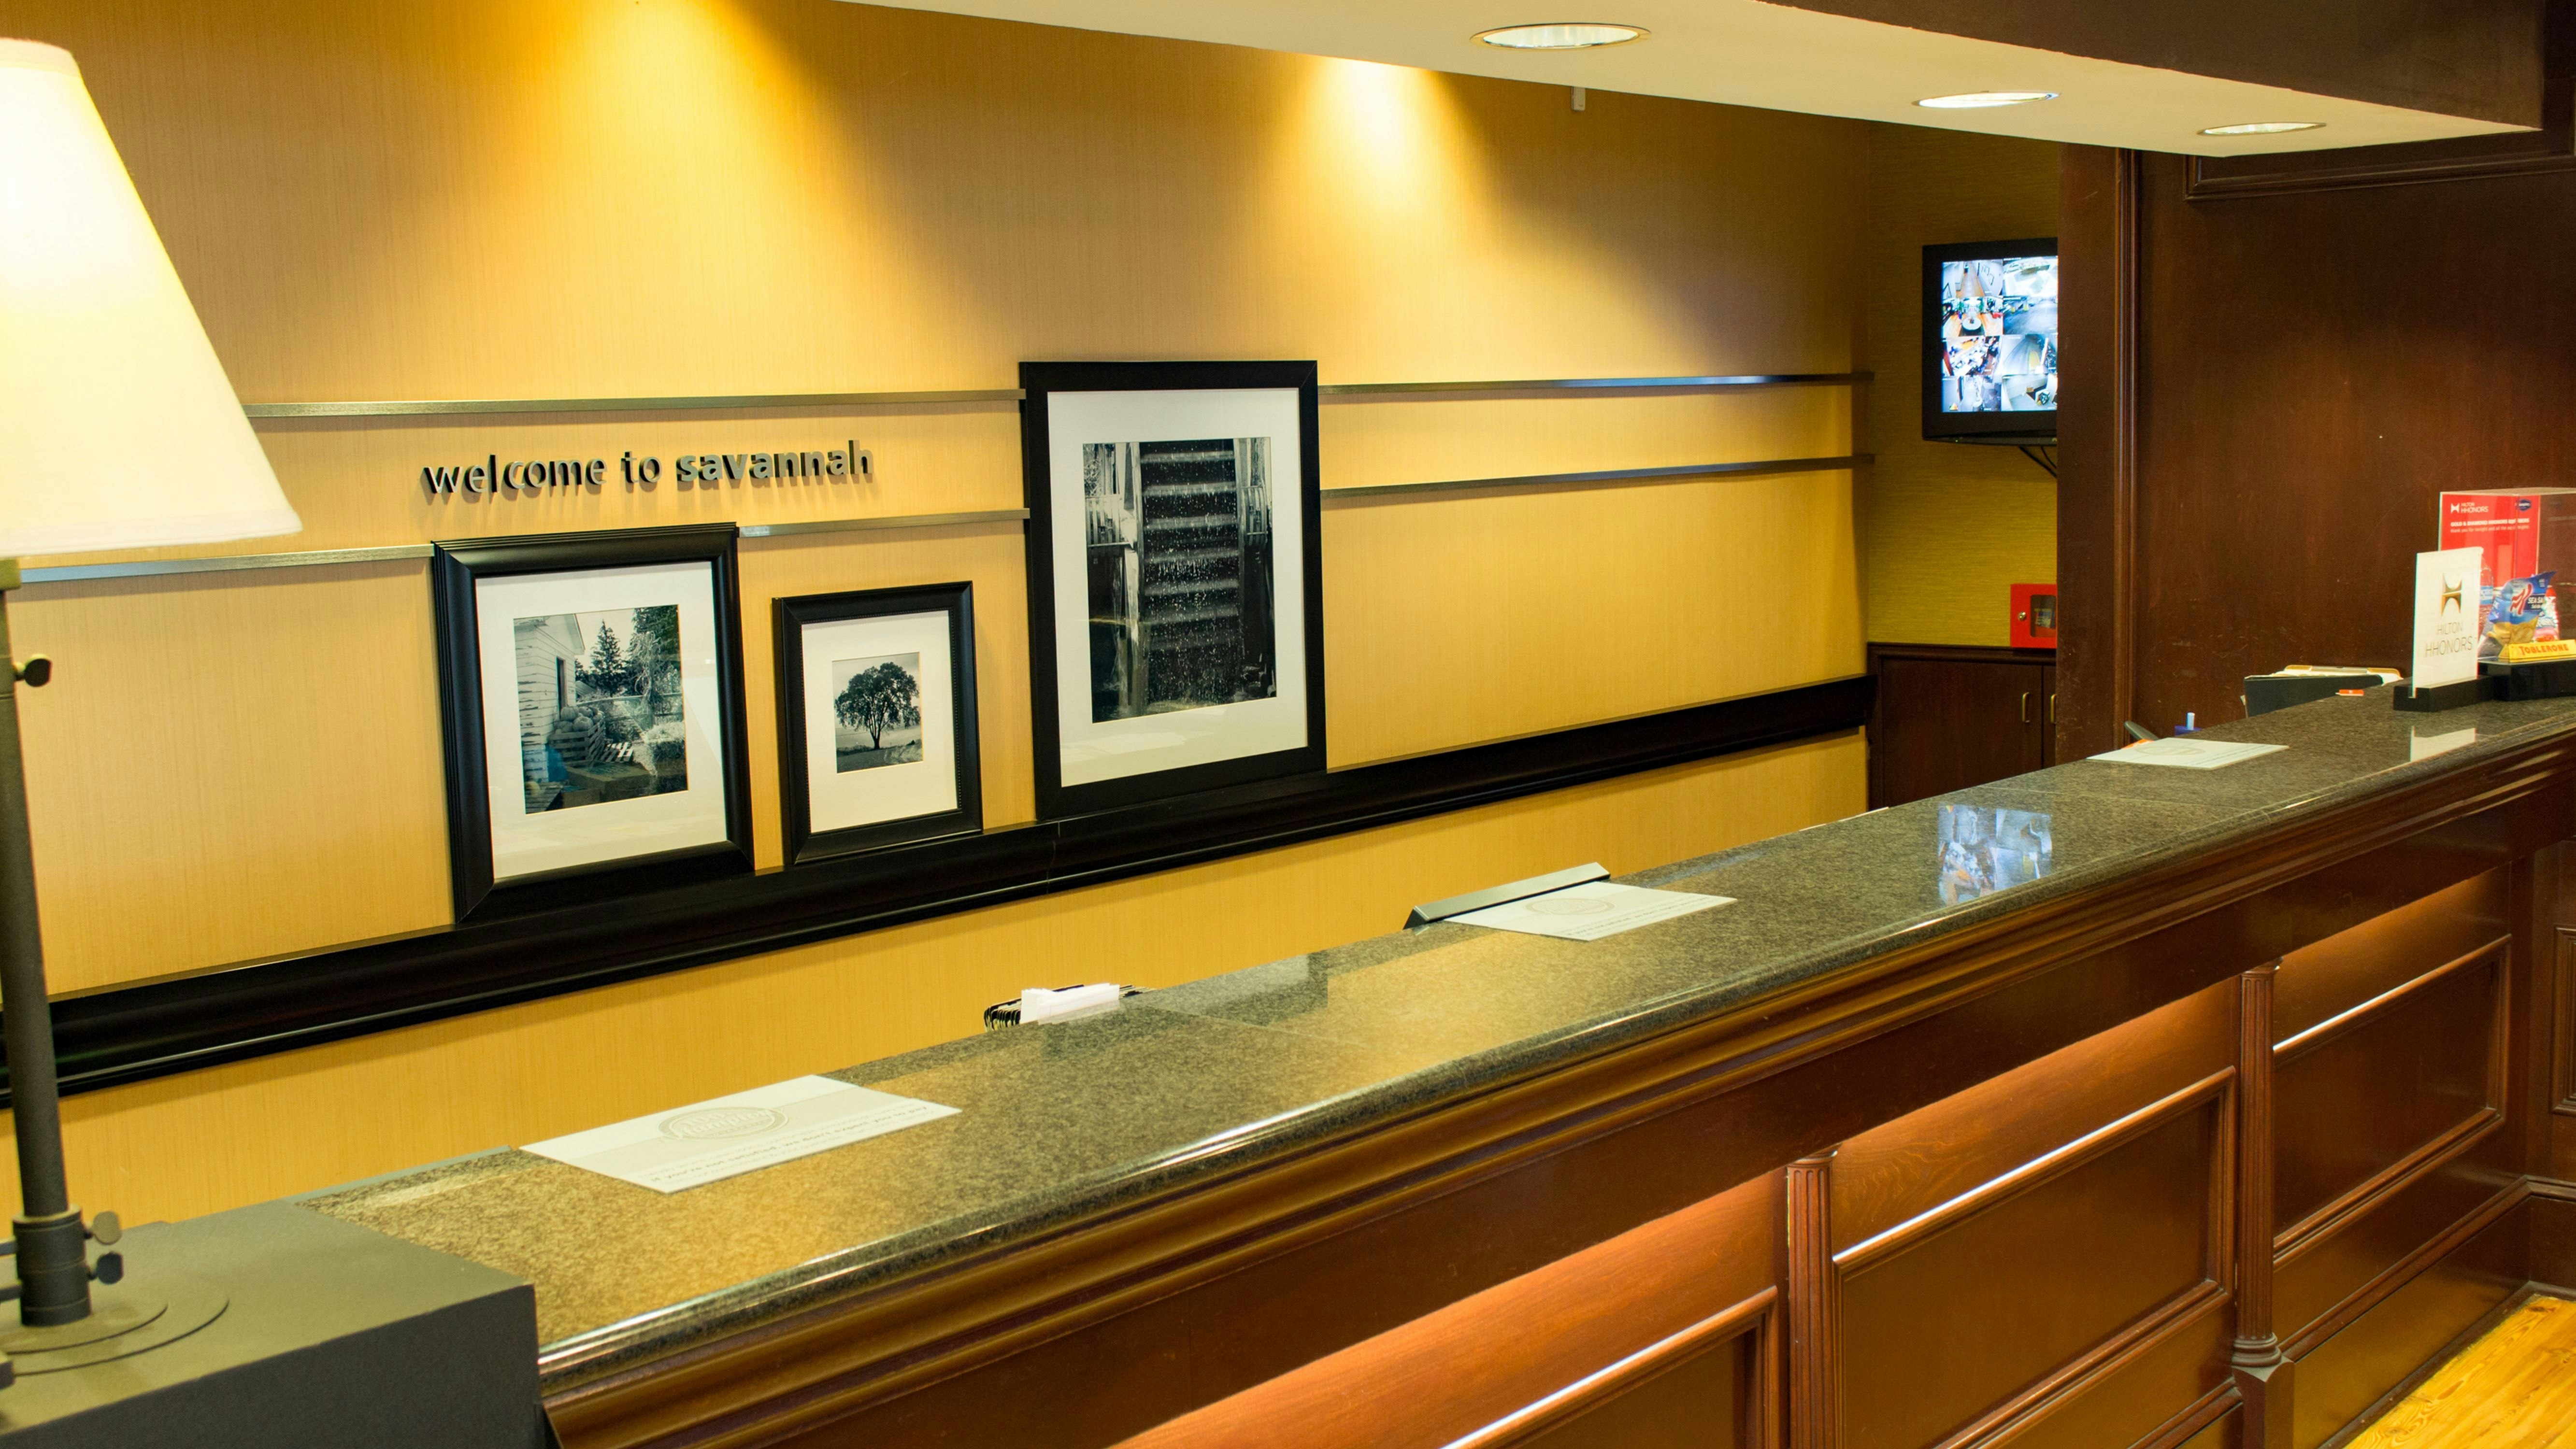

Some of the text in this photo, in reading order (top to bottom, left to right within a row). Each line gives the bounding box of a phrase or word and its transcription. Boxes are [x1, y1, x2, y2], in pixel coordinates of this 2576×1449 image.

[423, 440, 873, 494] welcome to savannah
[2436, 621, 2463, 636] HILTON
[2425, 635, 2473, 657] HHONORS
[2519, 644, 2570, 655] TOBLERONE
